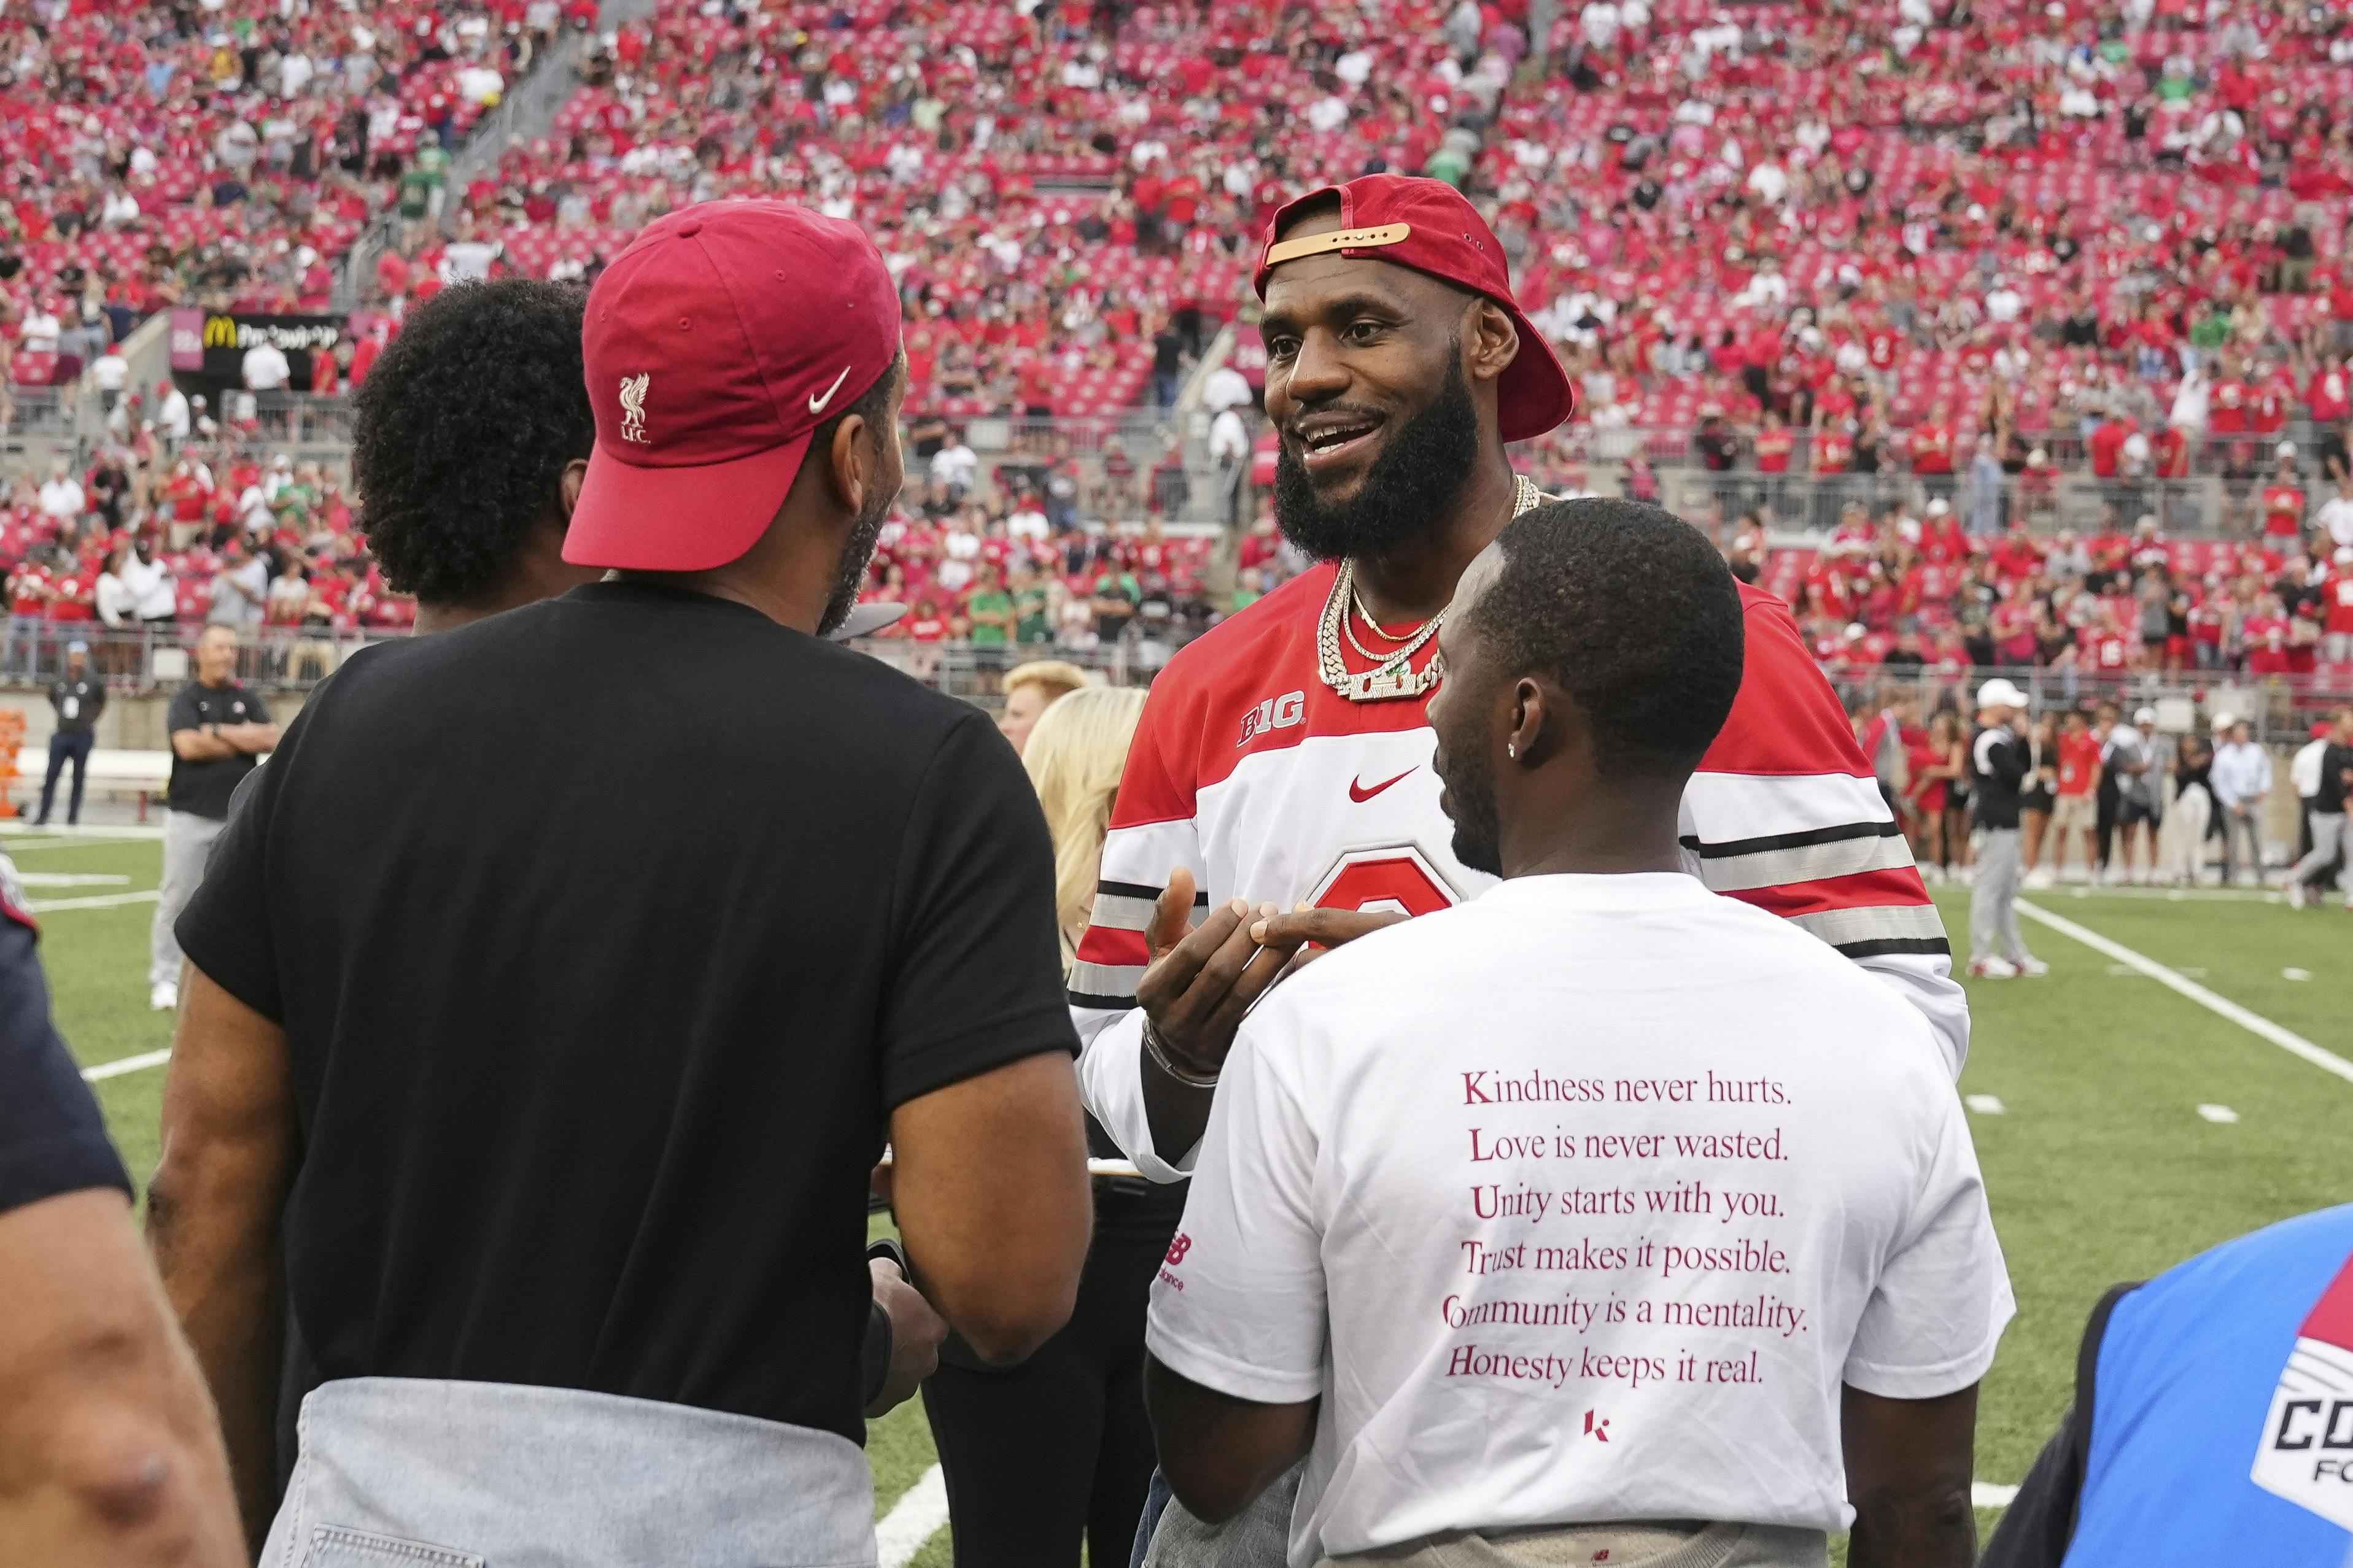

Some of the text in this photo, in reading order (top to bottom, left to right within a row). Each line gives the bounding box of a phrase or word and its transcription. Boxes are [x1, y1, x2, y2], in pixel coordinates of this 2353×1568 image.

[1463, 1070, 1792, 1106] Kindness never hurts.
[1470, 1125, 1788, 1162] Love is never wasted.
[1471, 1180, 1785, 1224] Unity starts with you.
[1460, 1235, 1791, 1277] Trust makes it possible.
[1442, 1291, 1808, 1337] Community is a mentality.
[1445, 1345, 1763, 1389] Honesty keeps it real.
